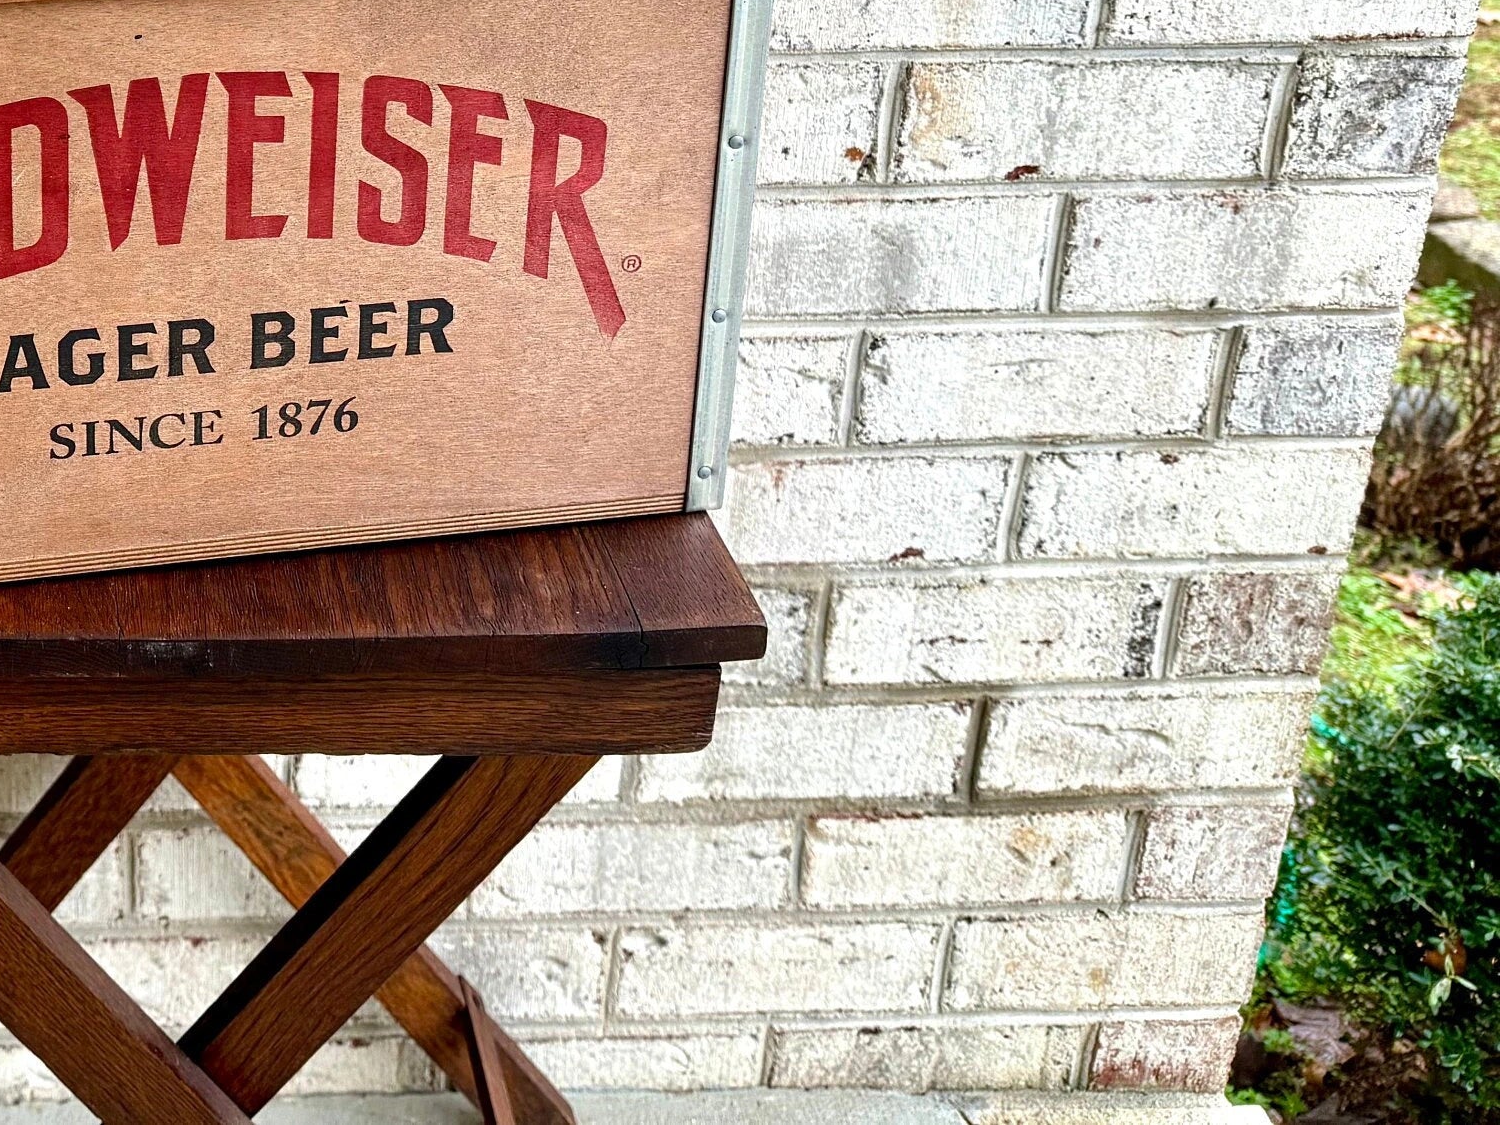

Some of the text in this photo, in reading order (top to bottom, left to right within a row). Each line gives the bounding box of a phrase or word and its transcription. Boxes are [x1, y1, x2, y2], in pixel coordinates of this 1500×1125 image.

[251, 297, 454, 369] BEER
[49, 397, 360, 460] SINCE 1876
